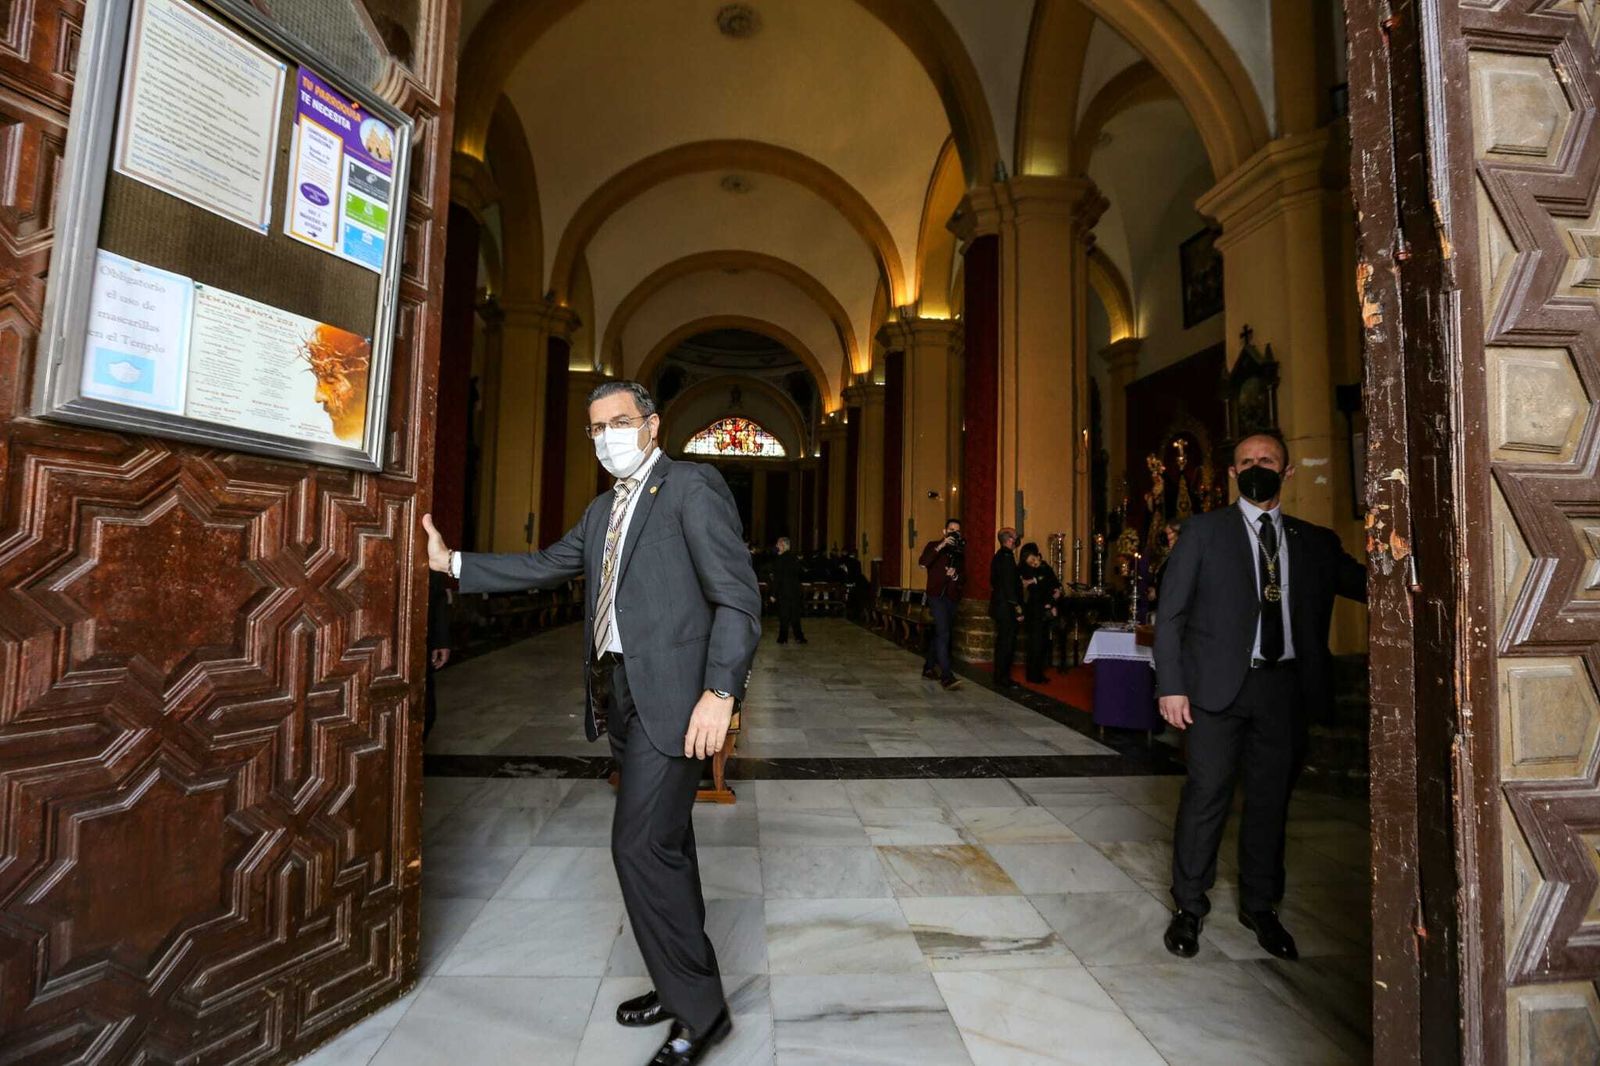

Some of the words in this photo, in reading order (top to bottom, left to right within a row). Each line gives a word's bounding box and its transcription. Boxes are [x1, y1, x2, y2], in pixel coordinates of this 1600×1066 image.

[300, 89, 312, 106] TE
[312, 98, 351, 131] NECESITA
[302, 75, 314, 91] TU
[314, 85, 361, 122] PARROQUIA
[100, 264, 166, 294] Obligatorio
[106, 290, 117, 300] el
[119, 296, 140, 306] uso
[142, 300, 156, 311] de
[198, 292, 241, 309] SEMANA
[244, 305, 273, 320] SANTA
[97, 311, 160, 333] mascarillas
[87, 329, 104, 339] en
[106, 332, 118, 342] el
[119, 334, 166, 354] Templo
